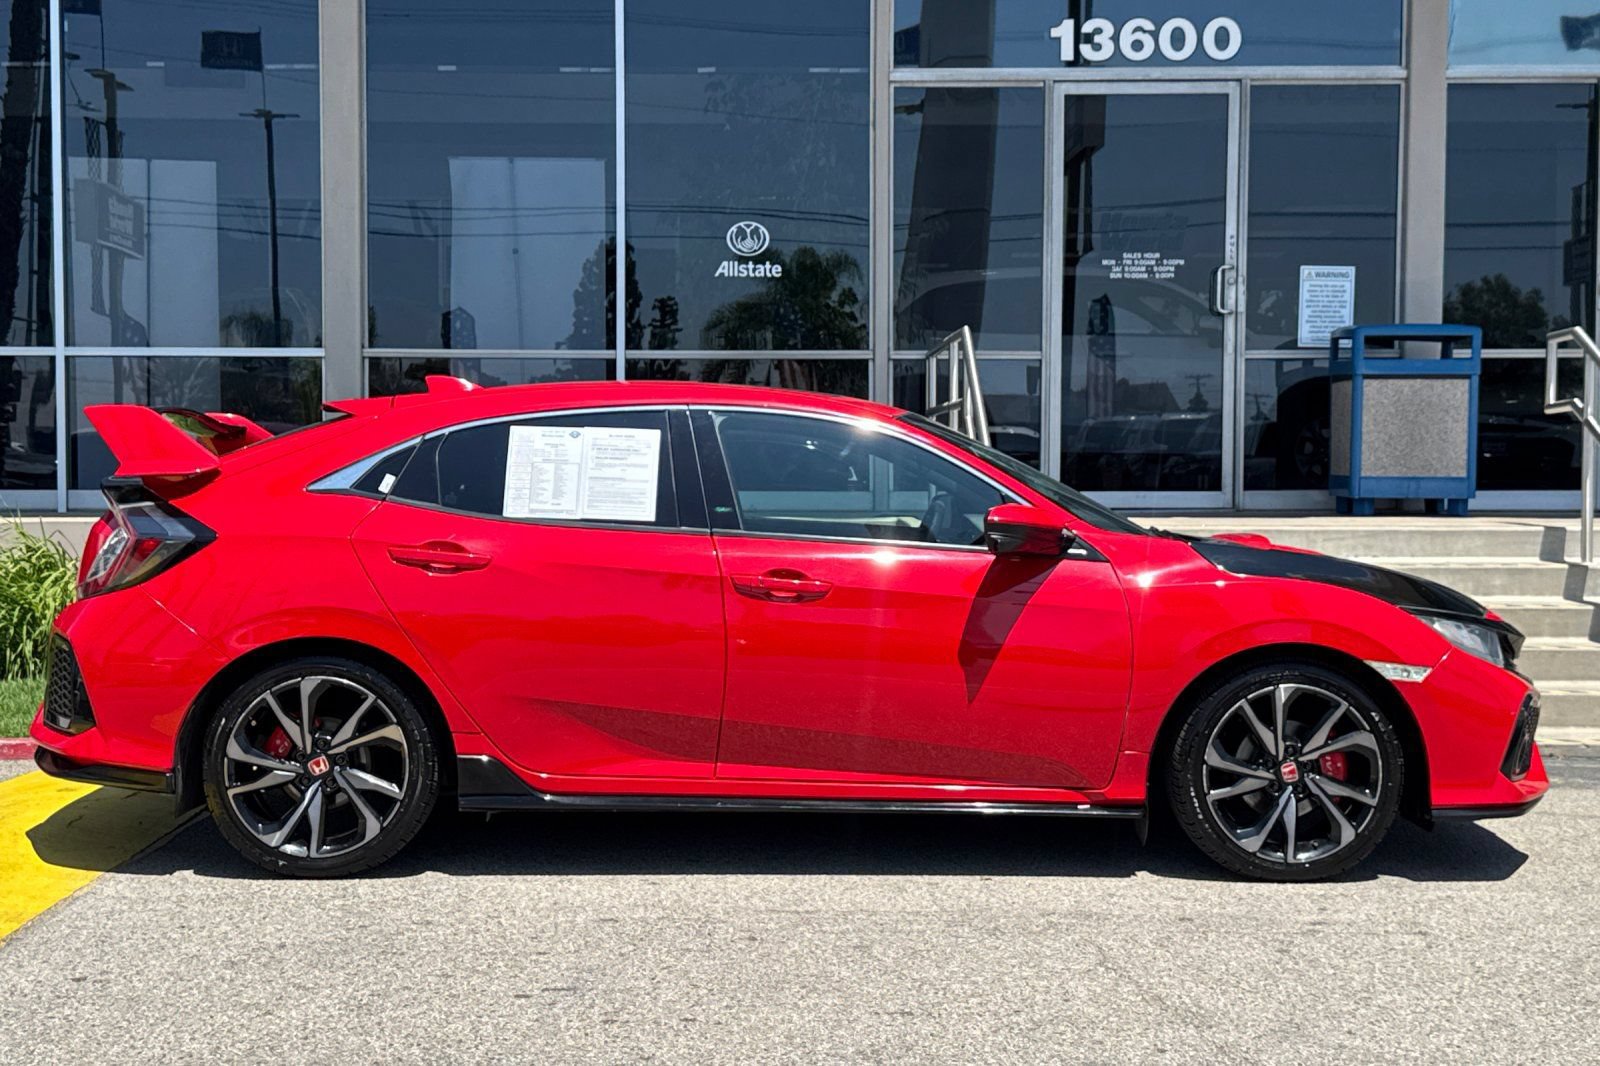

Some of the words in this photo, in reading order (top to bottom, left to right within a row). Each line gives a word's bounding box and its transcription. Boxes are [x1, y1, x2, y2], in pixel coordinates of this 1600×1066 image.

[1050, 17, 1242, 62] 13600
[714, 260, 782, 278] Allstate
[1314, 271, 1350, 279] WARNING
